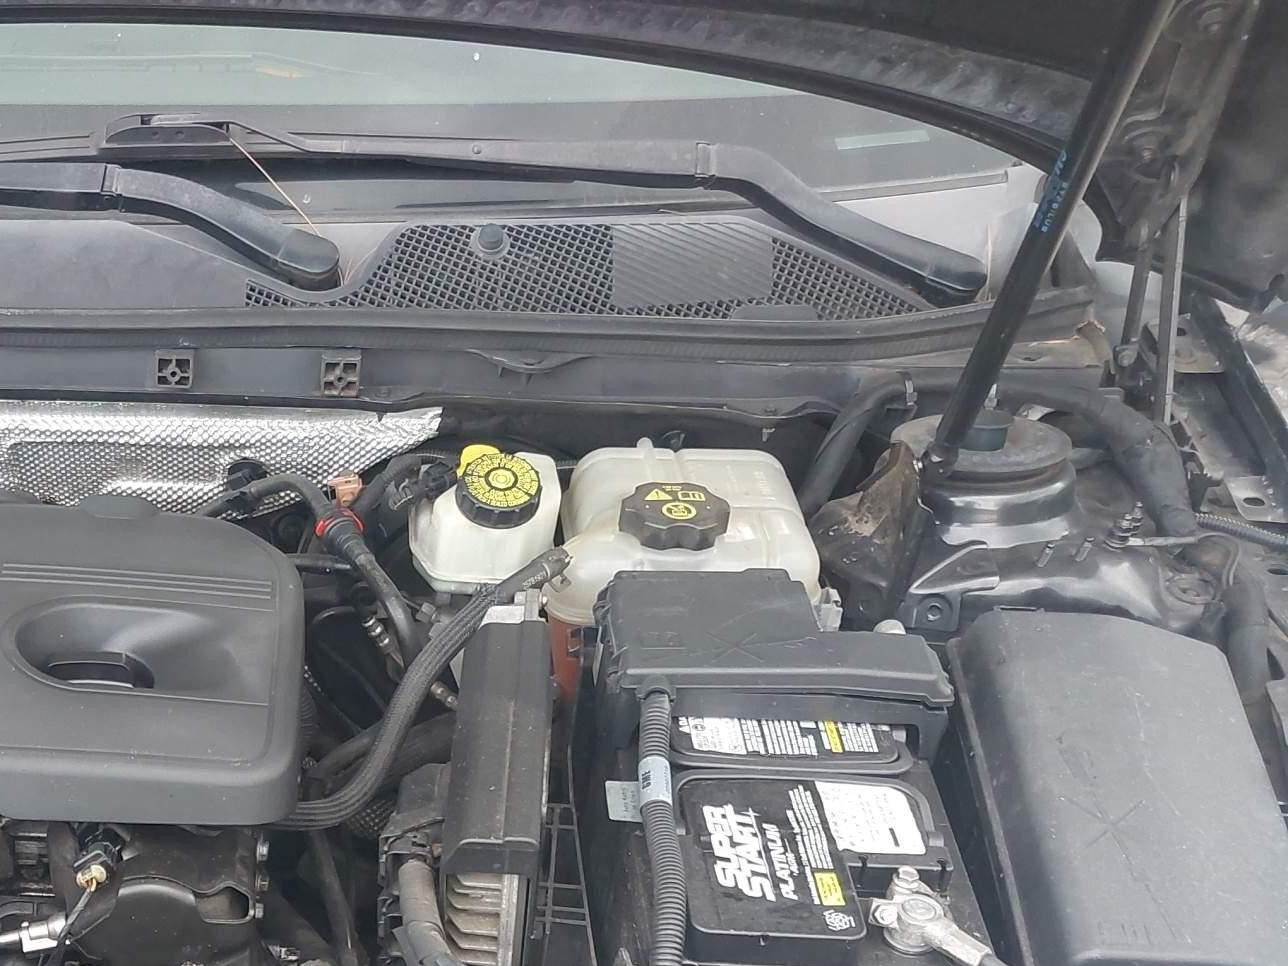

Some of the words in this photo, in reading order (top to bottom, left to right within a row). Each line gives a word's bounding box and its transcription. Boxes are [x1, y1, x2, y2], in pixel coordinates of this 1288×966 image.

[702, 803, 739, 888] SUPER
[728, 812, 776, 902] START
[762, 823, 799, 901] PLATINUM
